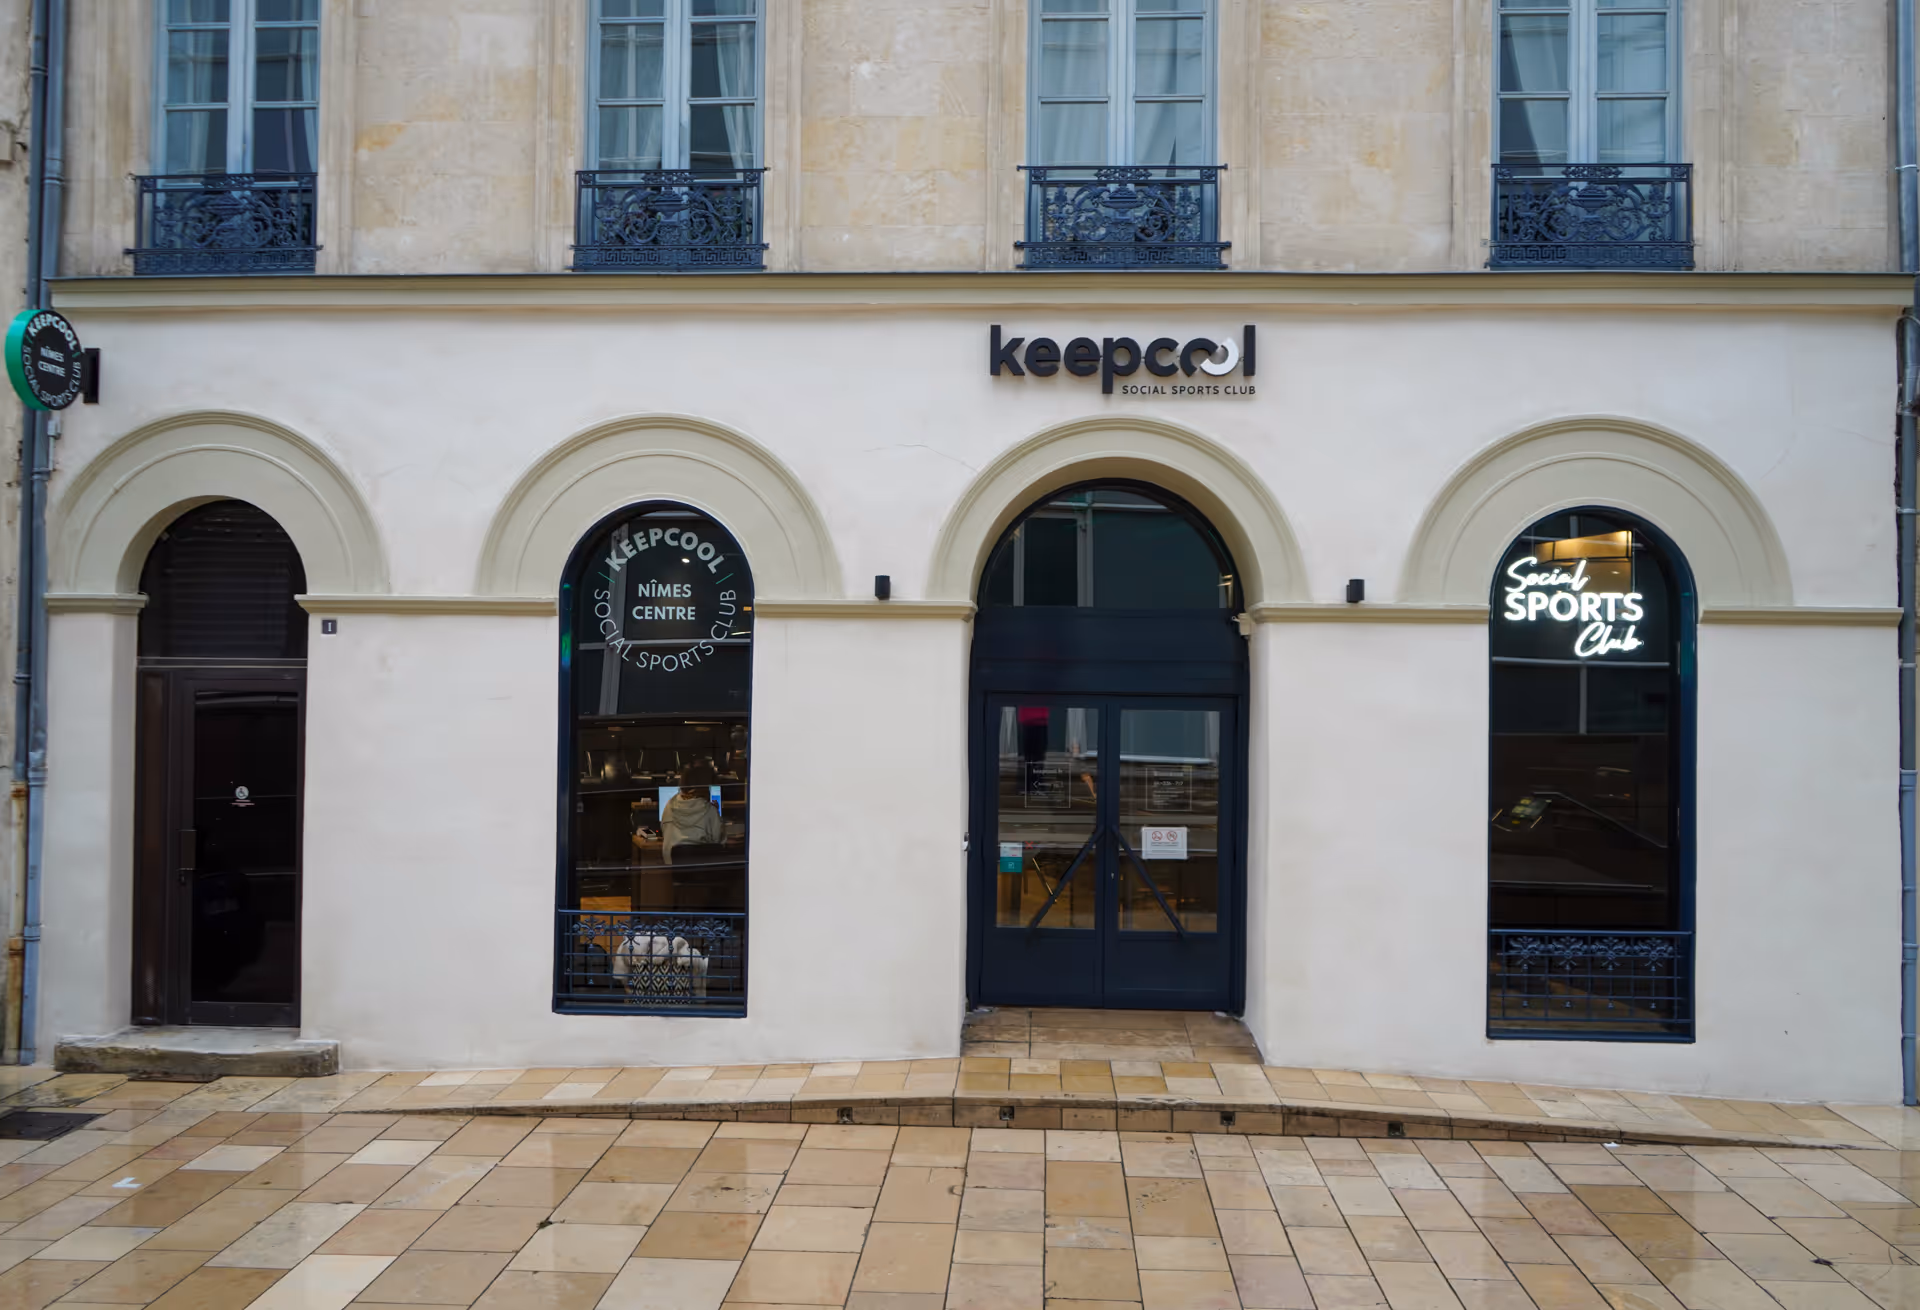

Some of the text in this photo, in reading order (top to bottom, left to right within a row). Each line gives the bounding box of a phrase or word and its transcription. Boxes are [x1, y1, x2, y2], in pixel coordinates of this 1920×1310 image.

[27, 313, 78, 351] KEEPCOOL
[22, 345, 82, 407] SOCIAL SPORTS CLUB
[38, 360, 66, 378] CENTRE
[989, 324, 1256, 394] keepcool
[1122, 385, 1256, 395] SOCIAL SPORTS CLUB
[605, 527, 725, 574] KEEPCOOL
[638, 579, 692, 598] NÎMES
[1504, 556, 1590, 592] Social
[632, 606, 696, 620] CENTRE
[1504, 591, 1643, 622] SPORTS
[594, 588, 736, 672] SOCIAL SPORTS CLUB
[1574, 622, 1644, 657] Club
